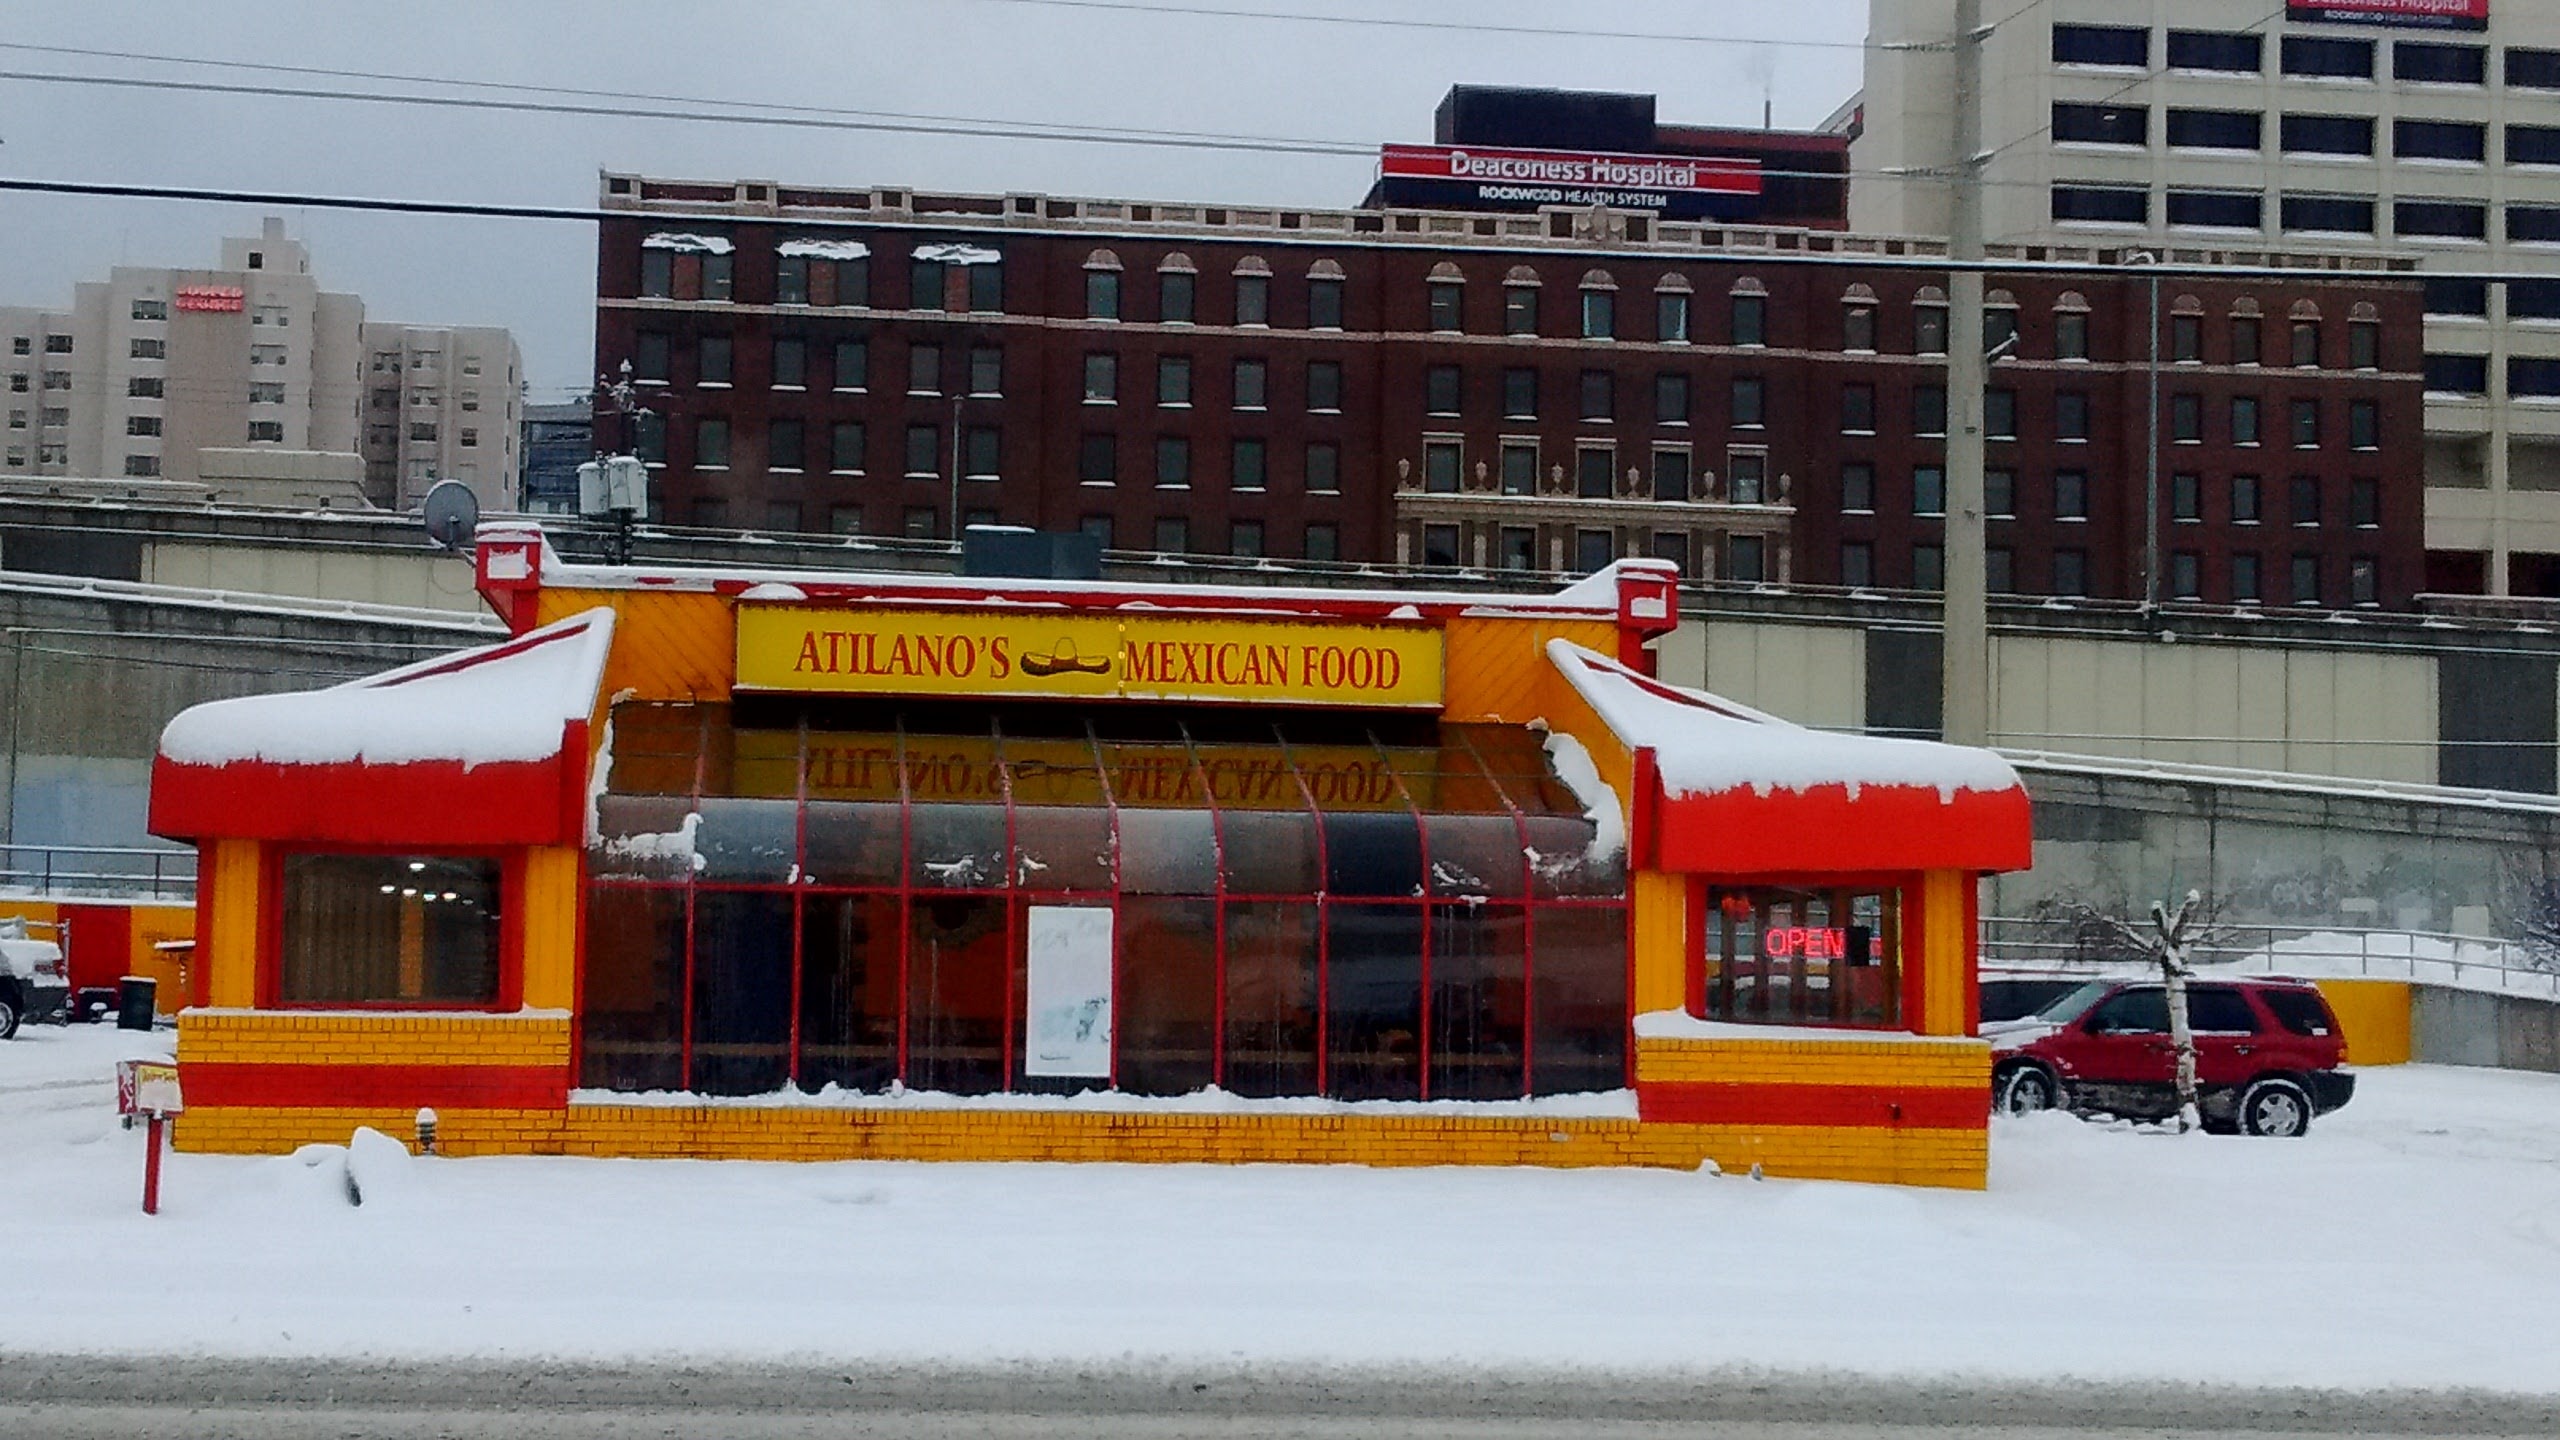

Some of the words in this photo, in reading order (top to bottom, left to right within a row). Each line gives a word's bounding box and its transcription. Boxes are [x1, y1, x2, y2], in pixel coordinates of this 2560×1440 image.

[1451, 151, 1586, 181] Deaconess
[1592, 158, 1696, 187] Hospital
[1479, 185, 1562, 201] ROCKWOOD
[1564, 189, 1615, 204] HEALTH
[1616, 193, 1667, 207] SYSTEM
[793, 631, 1011, 680] ATILANO'S
[1125, 641, 1291, 687] MEXICAN
[1301, 646, 1400, 690] FOOD
[1766, 928, 1846, 959] OPEN
